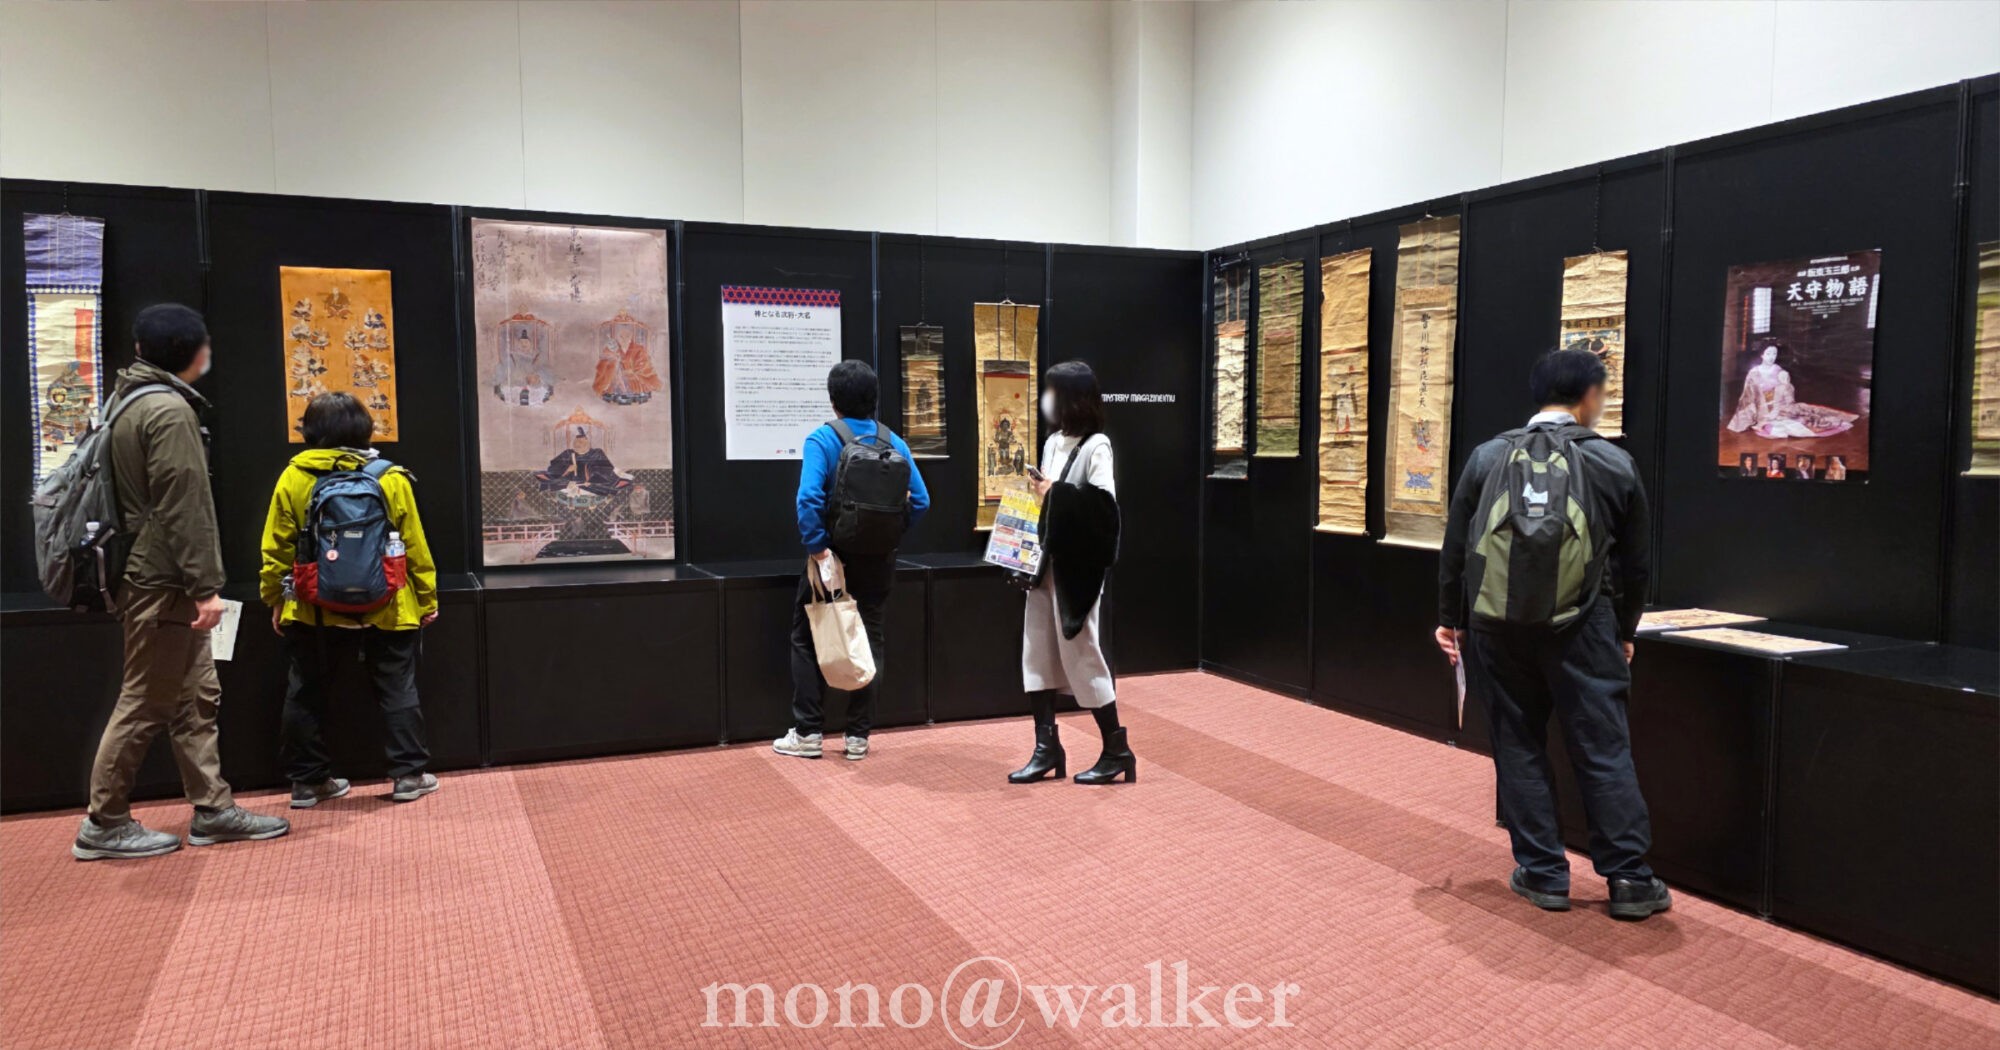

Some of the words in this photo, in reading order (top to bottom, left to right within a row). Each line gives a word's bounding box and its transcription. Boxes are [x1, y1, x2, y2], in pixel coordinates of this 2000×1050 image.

[1786, 276, 1869, 301] 天守物語
[1101, 393, 1130, 403] MYSTERY
